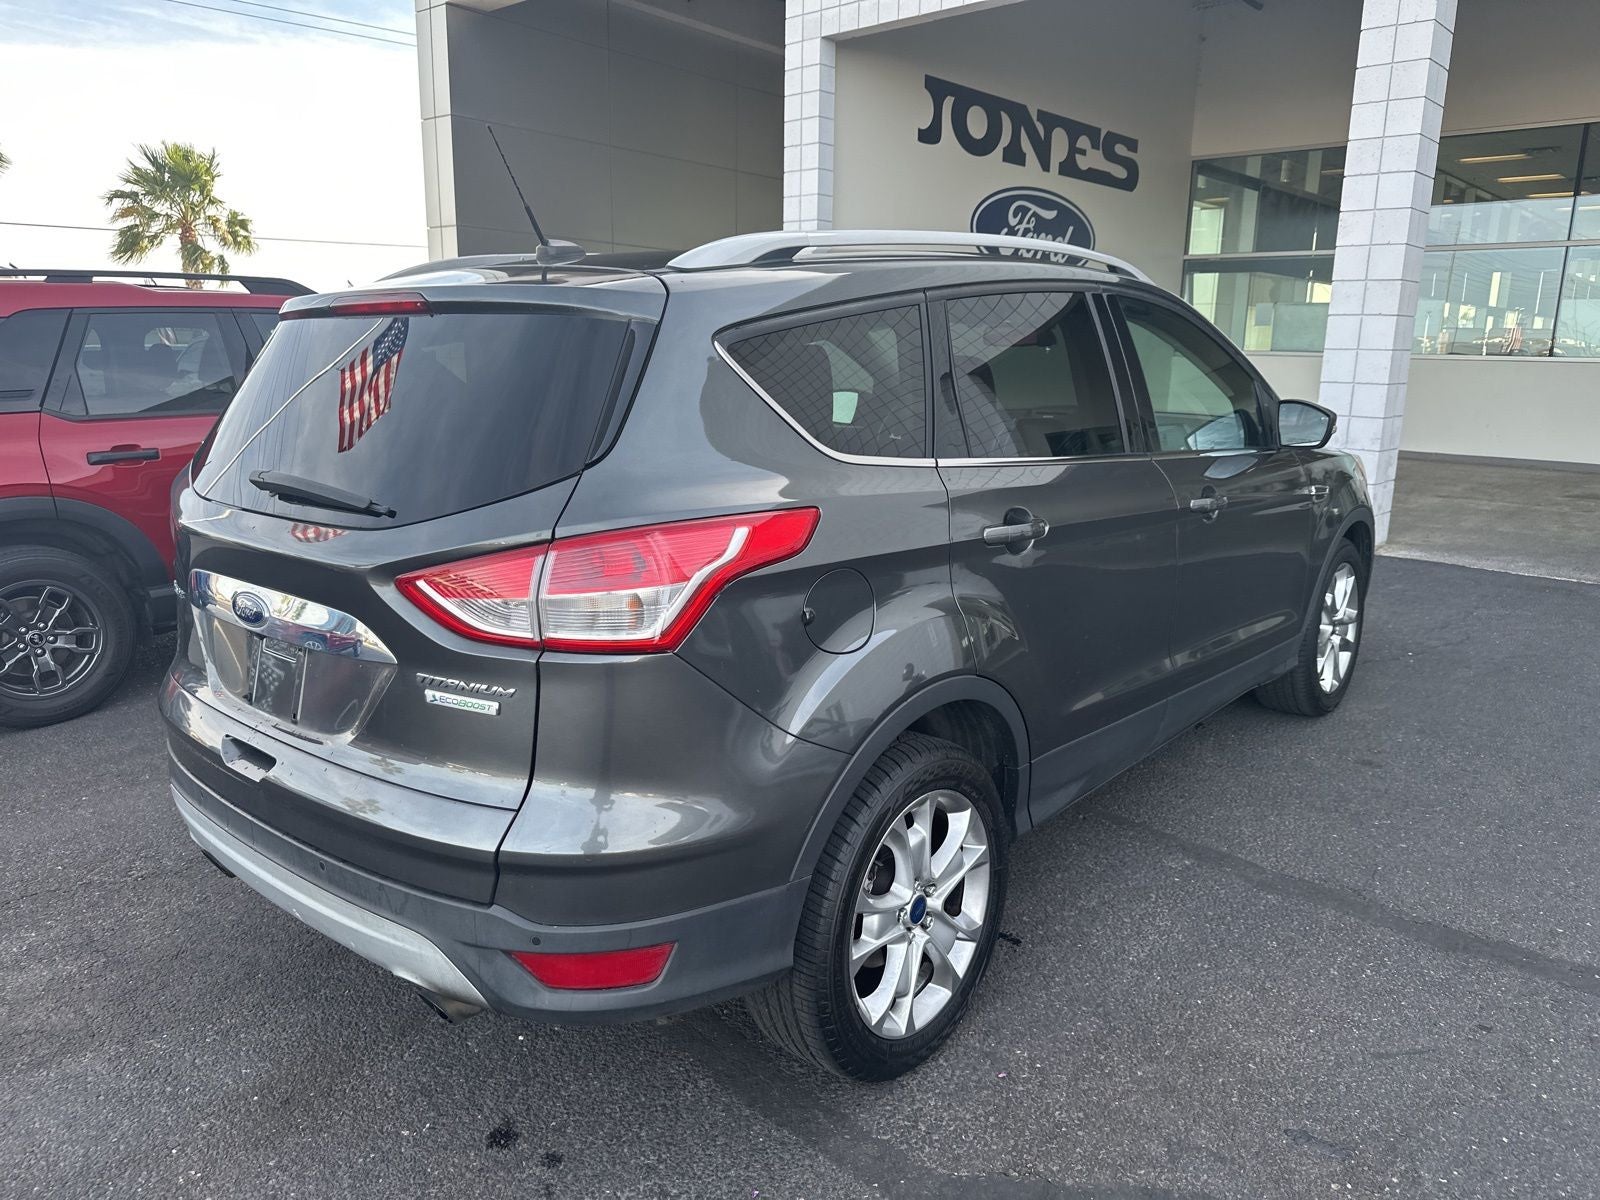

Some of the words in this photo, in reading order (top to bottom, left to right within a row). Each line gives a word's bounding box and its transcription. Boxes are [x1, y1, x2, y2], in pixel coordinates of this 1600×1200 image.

[918, 74, 1140, 192] JONES
[235, 598, 258, 620] Ford
[416, 672, 517, 698] TITANIUM
[439, 695, 493, 711] ECOBOOST
